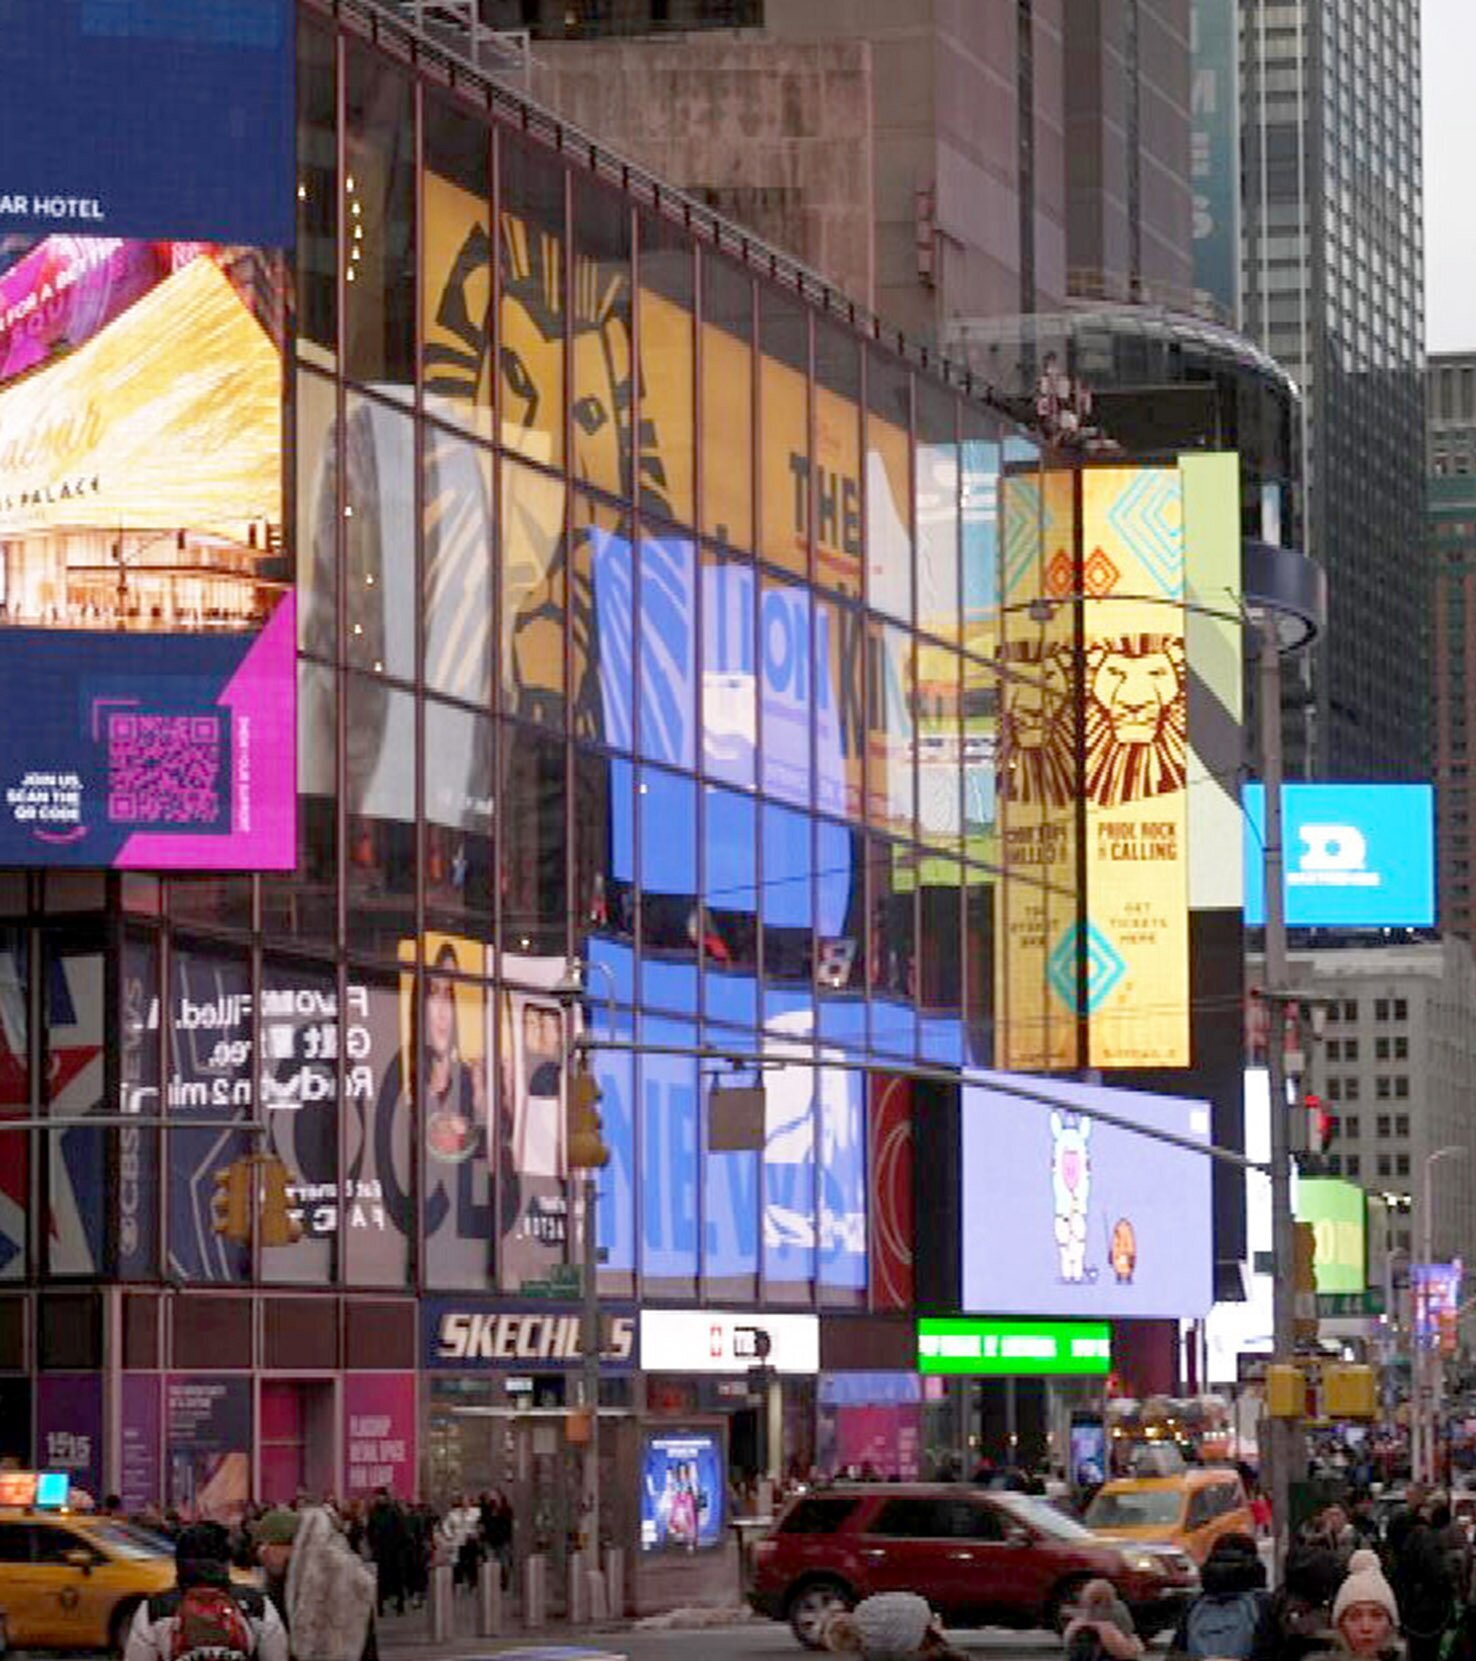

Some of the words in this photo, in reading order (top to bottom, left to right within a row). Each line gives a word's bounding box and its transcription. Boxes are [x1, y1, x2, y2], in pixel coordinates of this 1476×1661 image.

[0, 196, 28, 214] AR
[34, 198, 104, 218] HOTEL
[789, 451, 859, 556] THE
[7, 788, 49, 803] SCAN
[52, 789, 80, 803] THE
[39, 806, 80, 820] CODE
[1097, 822, 1137, 840] PRIDE
[1141, 822, 1176, 840] ROCK
[1110, 843, 1177, 861] CALLING
[437, 1311, 635, 1361] SKECHES
